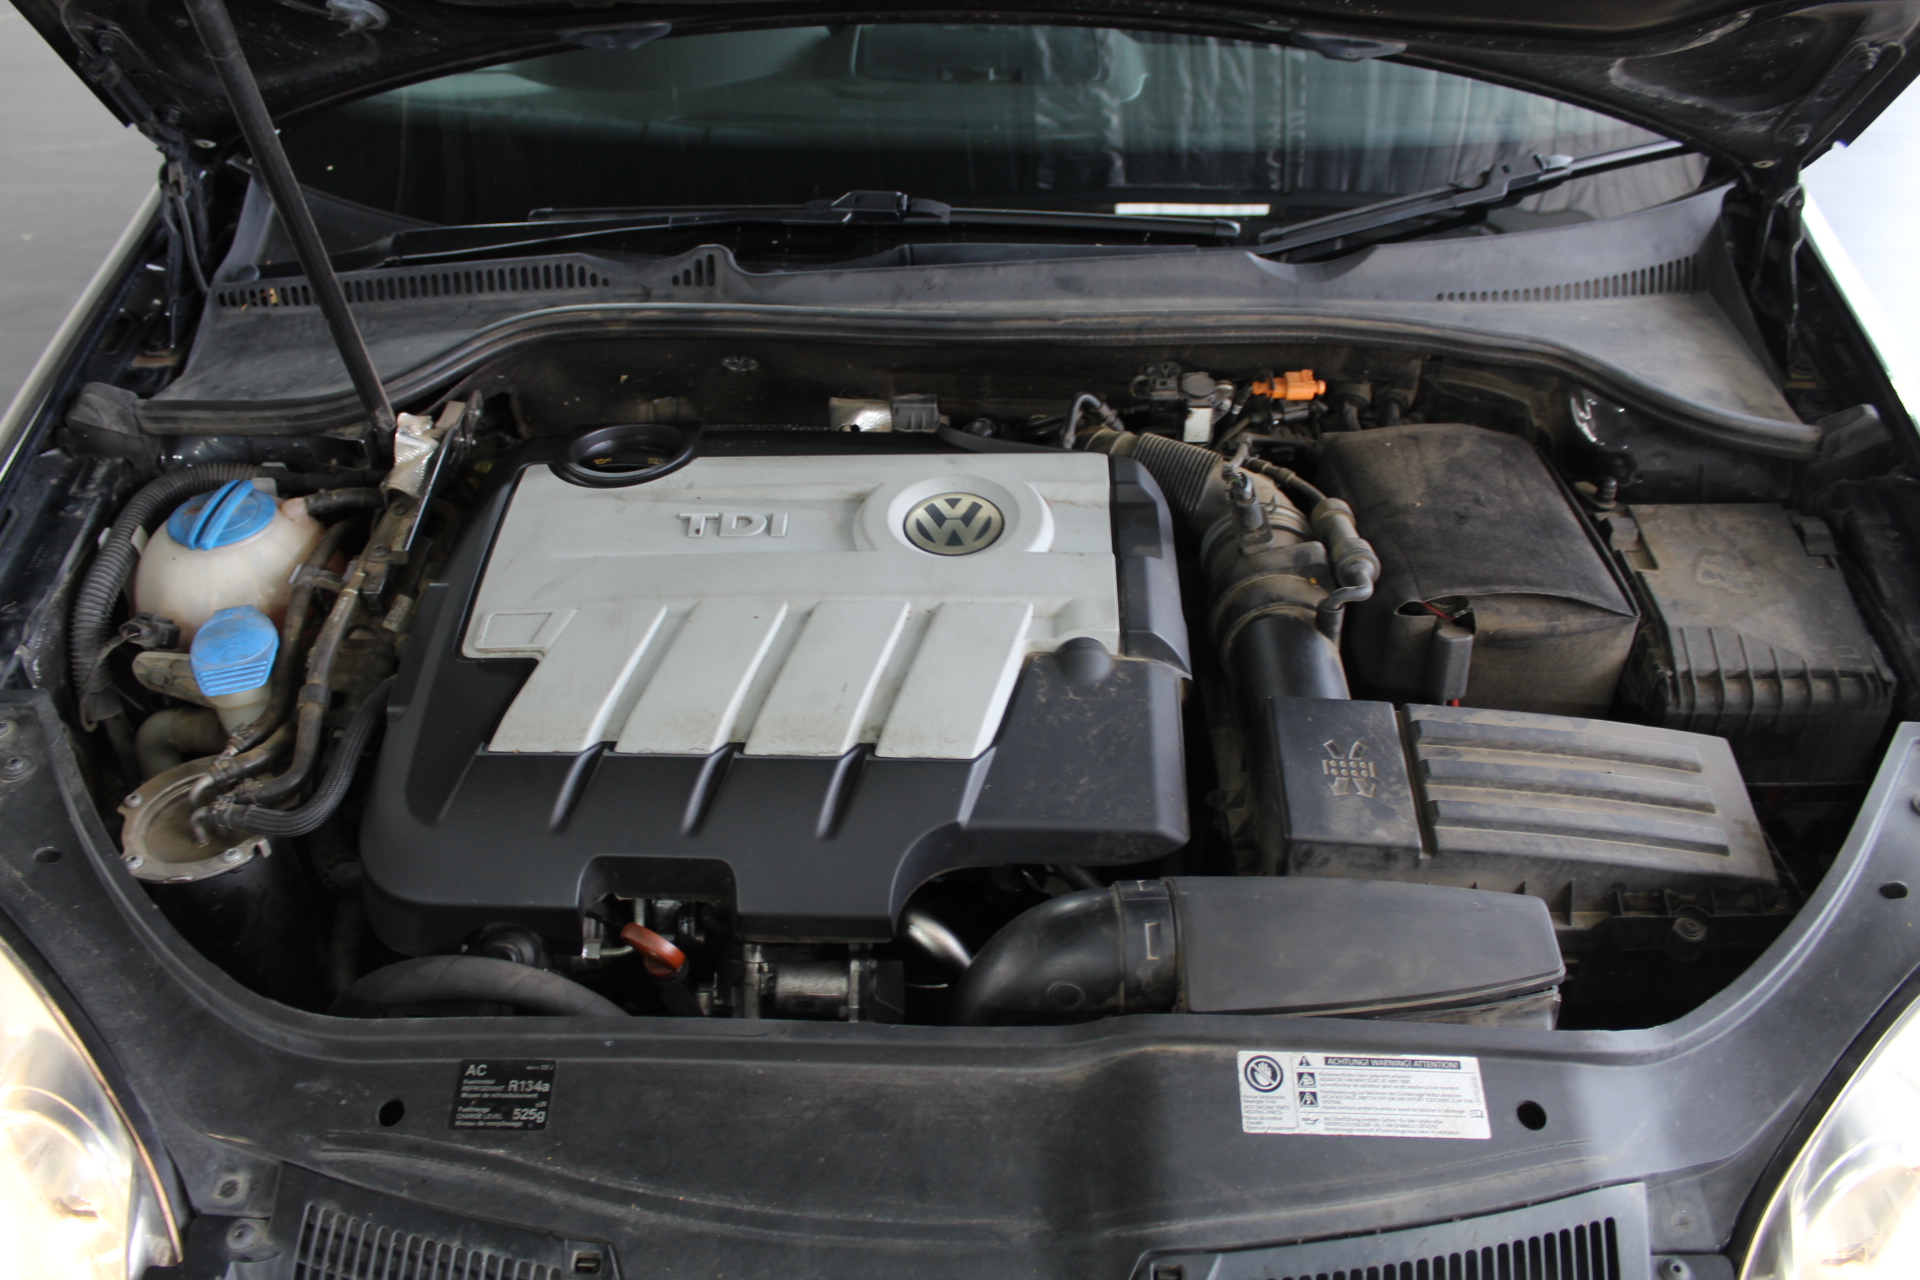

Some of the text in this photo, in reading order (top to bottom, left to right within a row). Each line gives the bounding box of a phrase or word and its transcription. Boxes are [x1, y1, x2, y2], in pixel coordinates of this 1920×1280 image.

[678, 511, 790, 538] TDI
[465, 1064, 487, 1076] AC
[508, 1080, 550, 1092] R134a
[512, 1108, 546, 1123] 525g
